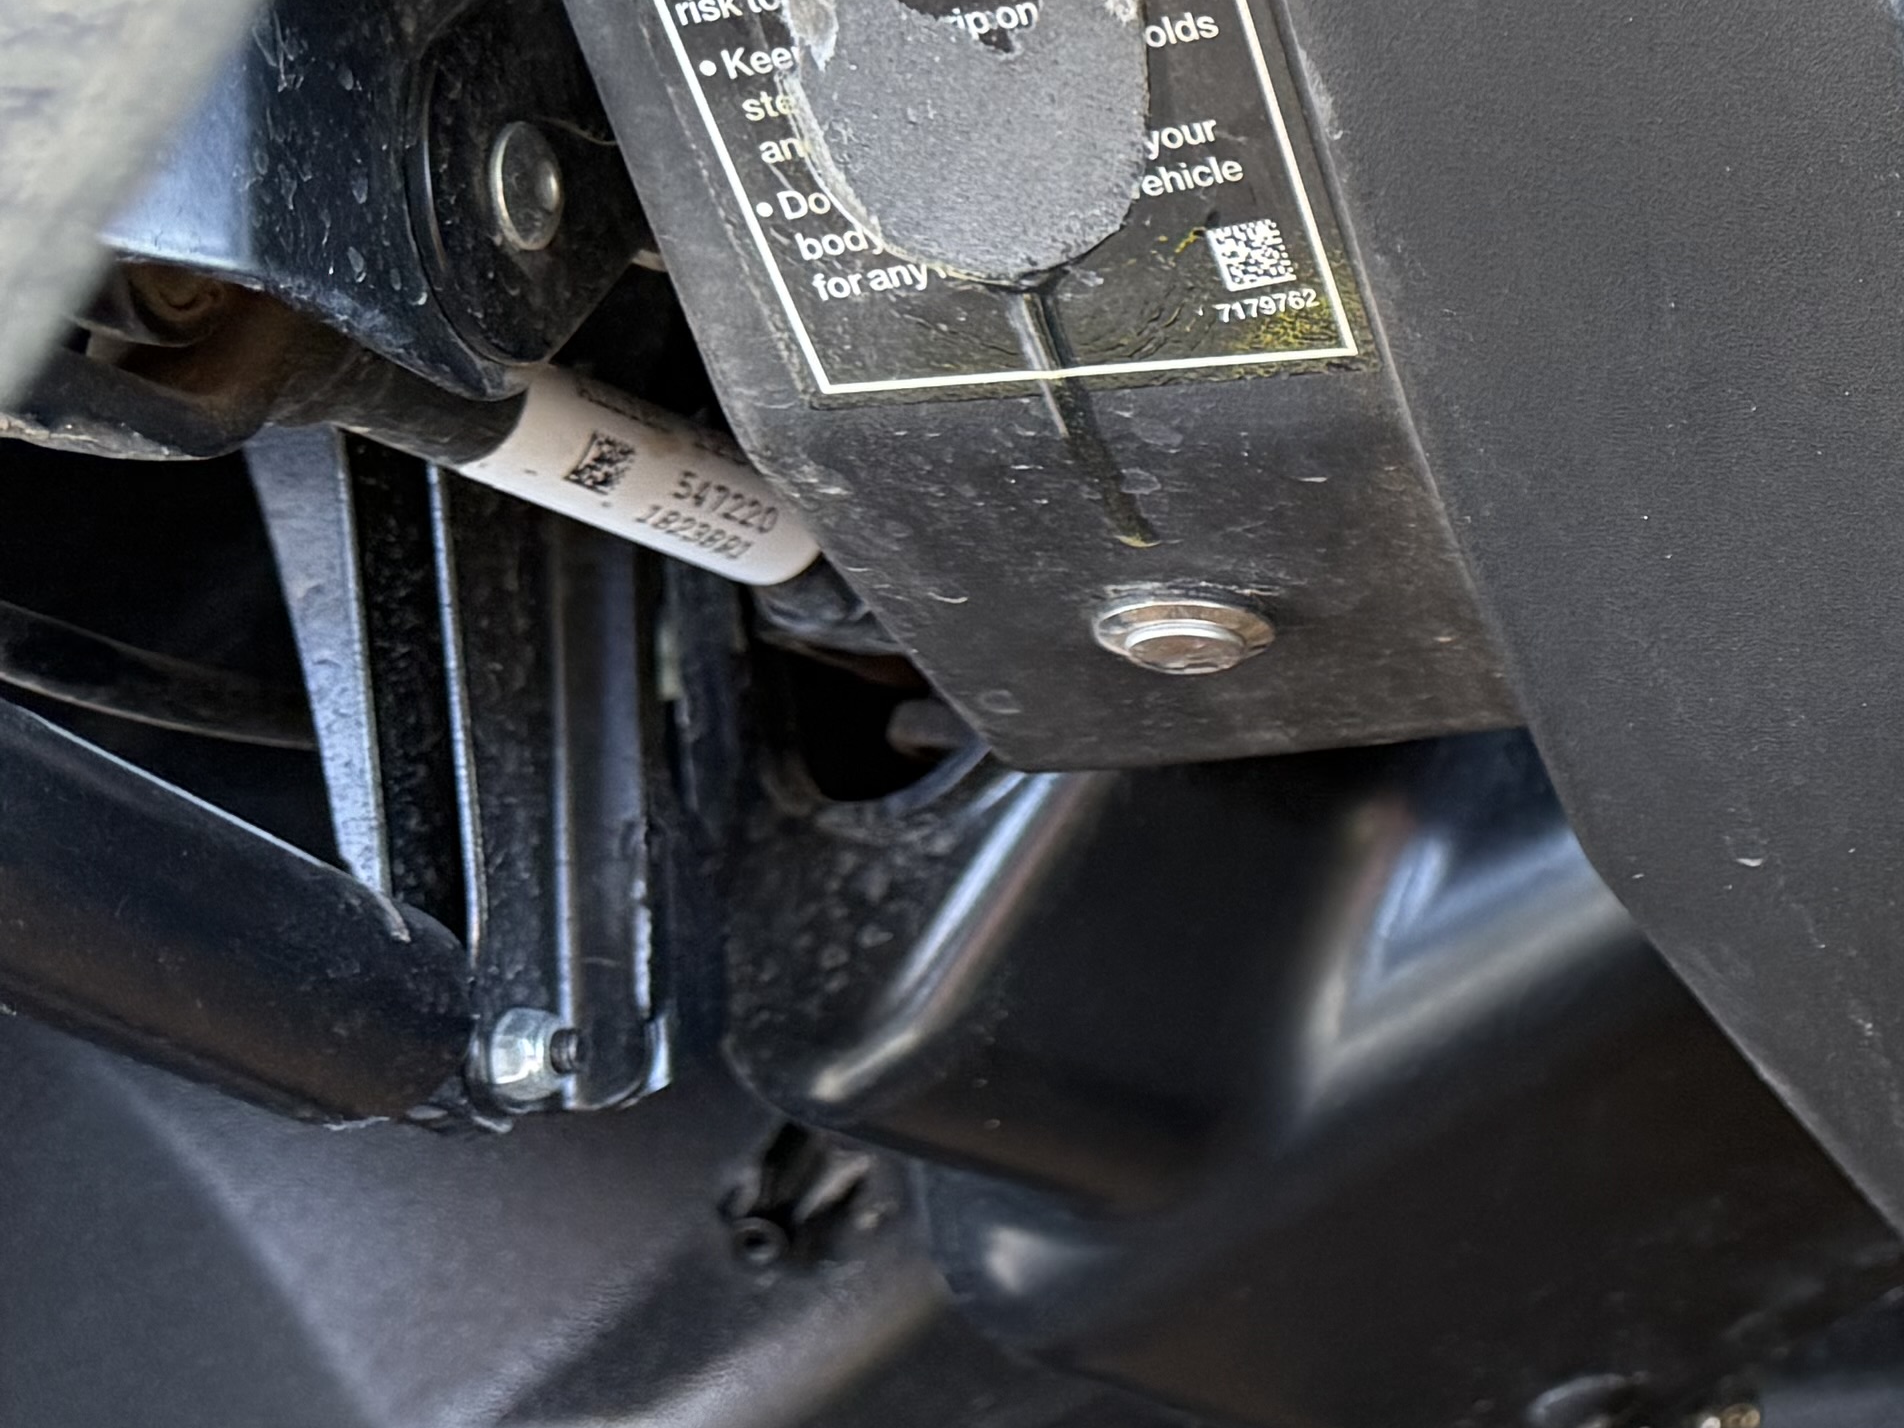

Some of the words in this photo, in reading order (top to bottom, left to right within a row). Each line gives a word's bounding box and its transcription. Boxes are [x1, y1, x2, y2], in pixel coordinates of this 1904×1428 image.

[995, 1, 1040, 30] on
[1130, 155, 1244, 199] ehicle
[776, 189, 832, 221] Do
[811, 271, 863, 302] for
[866, 262, 929, 292] any
[1211, 287, 1321, 323] 7179762
